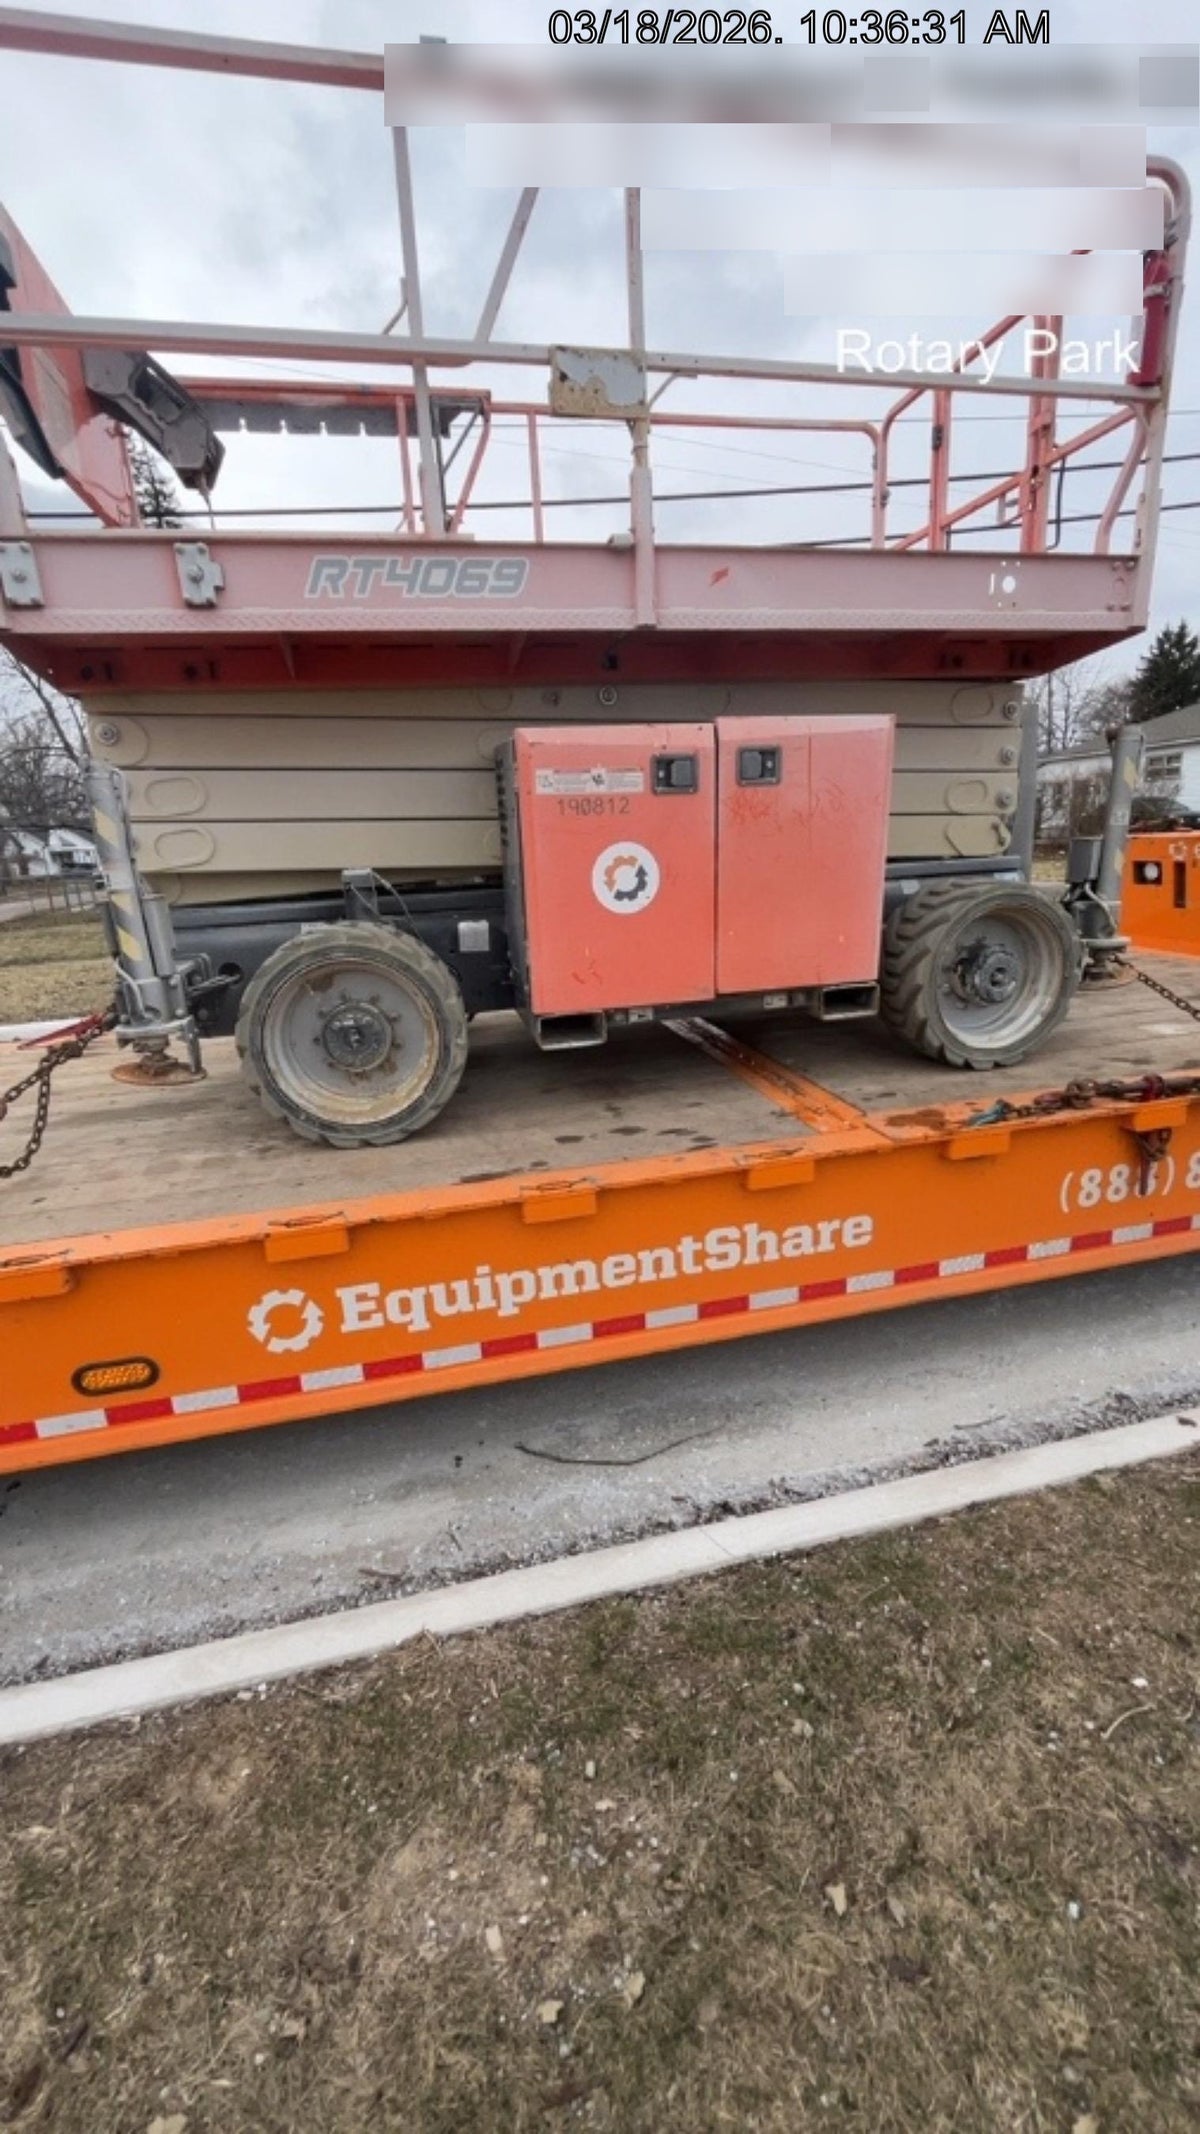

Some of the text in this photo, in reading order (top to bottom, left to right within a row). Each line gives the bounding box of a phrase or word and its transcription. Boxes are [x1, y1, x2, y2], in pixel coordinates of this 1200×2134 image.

[304, 555, 529, 598] RT4069
[557, 797, 630, 816] 190812
[336, 1214, 874, 1334] EquipmentShare
